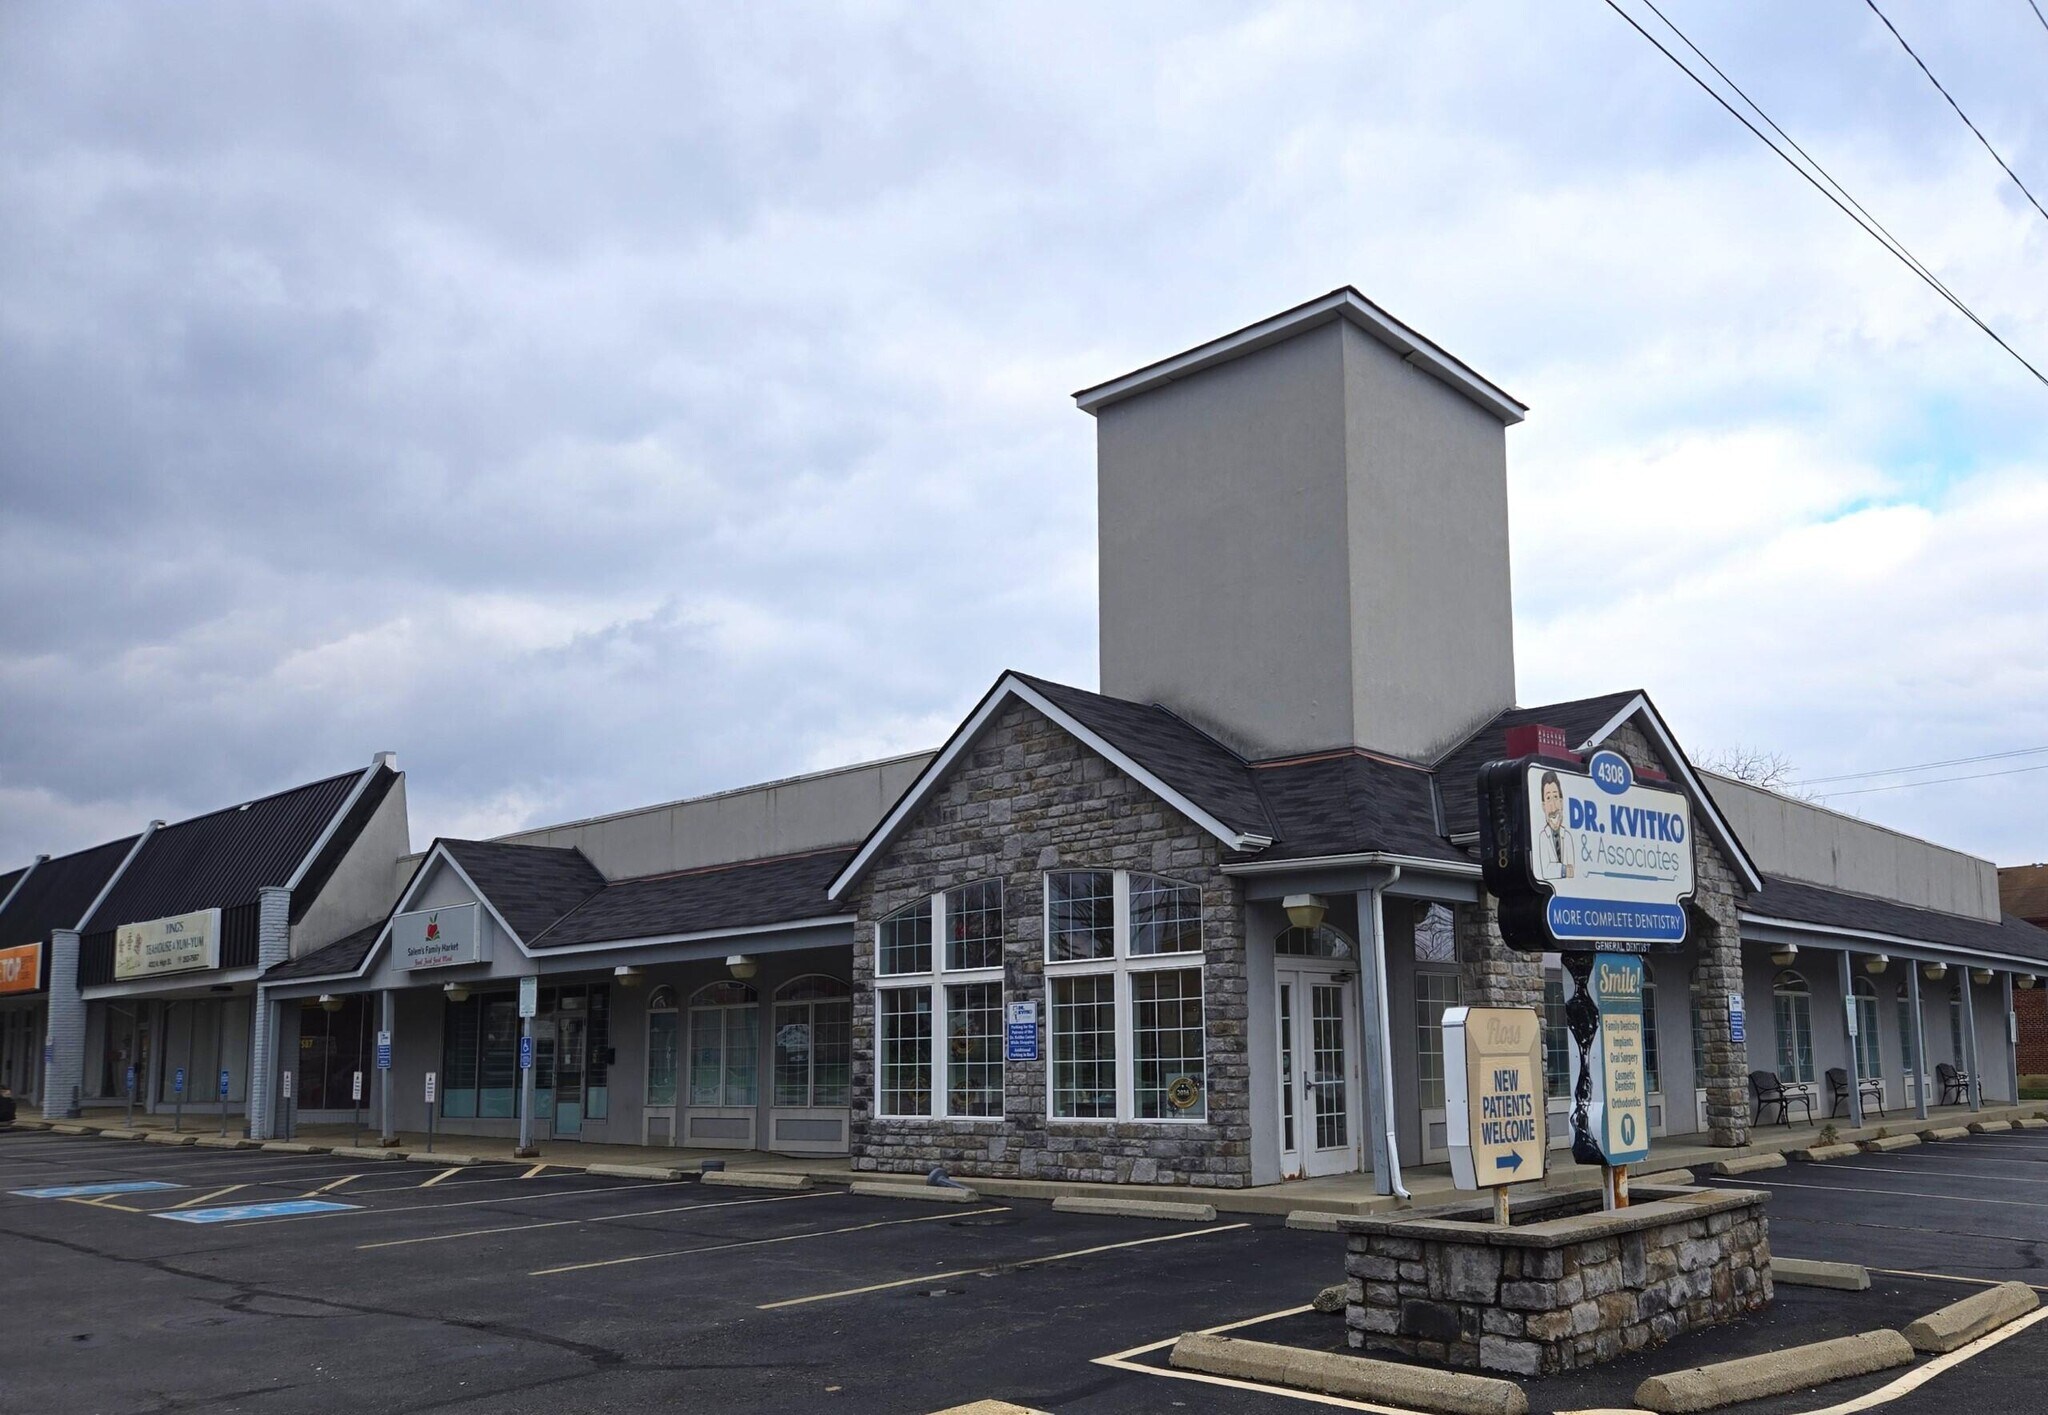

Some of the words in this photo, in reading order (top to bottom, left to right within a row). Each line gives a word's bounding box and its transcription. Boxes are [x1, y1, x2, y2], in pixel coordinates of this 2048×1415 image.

[1598, 762, 1625, 785] 4308
[1568, 797, 1605, 834] DR.
[1610, 804, 1685, 844] KVITKO
[1581, 834, 1593, 862] &
[1597, 836, 1680, 871] Associates
[1553, 909, 1582, 925] MORE
[1584, 911, 1633, 928] COMPLETE
[1635, 913, 1681, 930] DENTISTRY
[407, 946, 425, 956] Salem's
[425, 944, 440, 955] Family
[441, 942, 459, 952] Market
[1595, 941, 1625, 951] GENERAL
[1626, 943, 1651, 953] DENTIST
[0, 957, 21, 983] TOP
[1600, 963, 1640, 994] Smile!
[1487, 1017, 1521, 1045] Floss
[1605, 1020, 1620, 1033] Family
[1620, 1021, 1639, 1033] Dentistry
[1613, 1036, 1634, 1049] Implants
[1610, 1052, 1620, 1063] Oral
[1620, 1053, 1638, 1065] Surgery
[1494, 1069, 1519, 1092] NEW
[1614, 1069, 1636, 1080] Cosmetic
[1614, 1081, 1636, 1093] Dentistry
[1482, 1093, 1532, 1119] PATIENTS
[1611, 1096, 1641, 1109] Orthodontics
[1481, 1119, 1536, 1145] WELCOME
